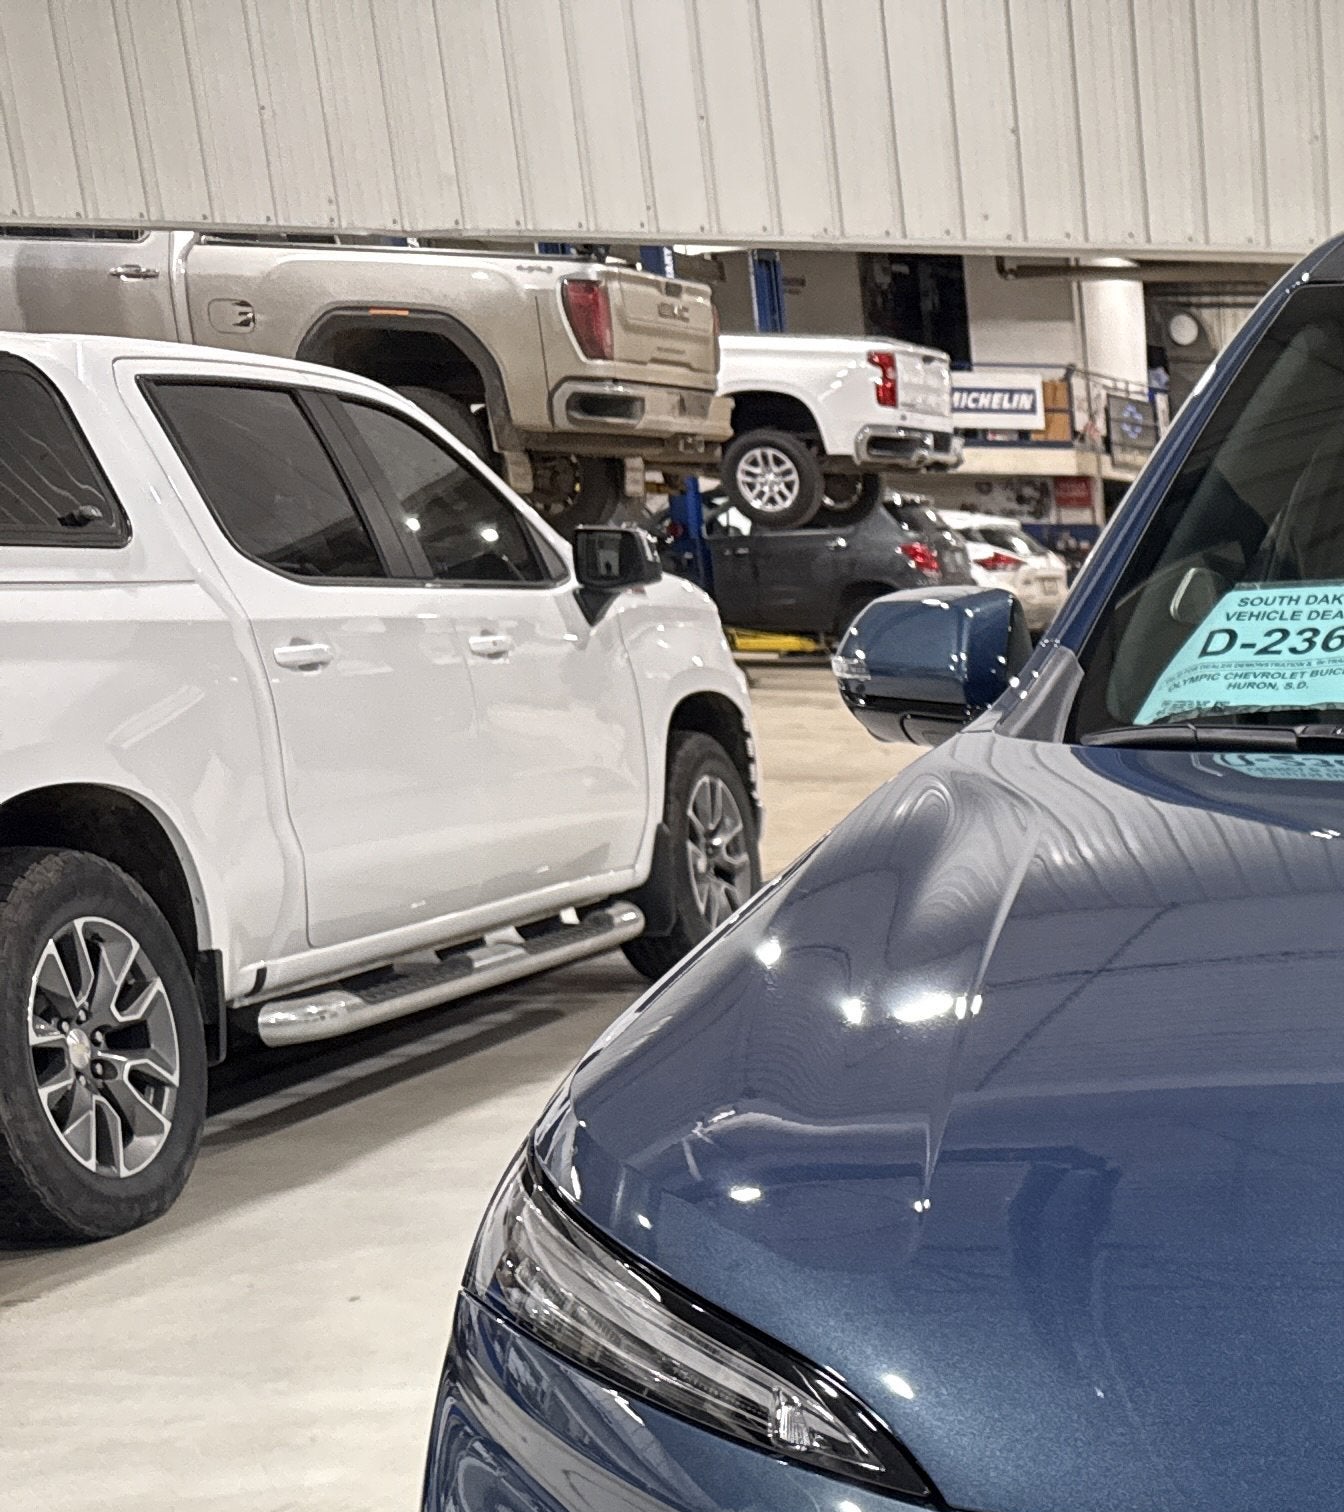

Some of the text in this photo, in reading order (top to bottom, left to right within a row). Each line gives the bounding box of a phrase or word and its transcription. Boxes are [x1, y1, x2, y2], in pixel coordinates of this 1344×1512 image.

[1237, 595, 1301, 607] SOUTH
[1225, 609, 1304, 622] VEHICLE
[1167, 672, 1221, 693] OLYMPIC
[1223, 670, 1306, 681] CHEVROLET
[1226, 681, 1309, 691] HURON, S.D.
